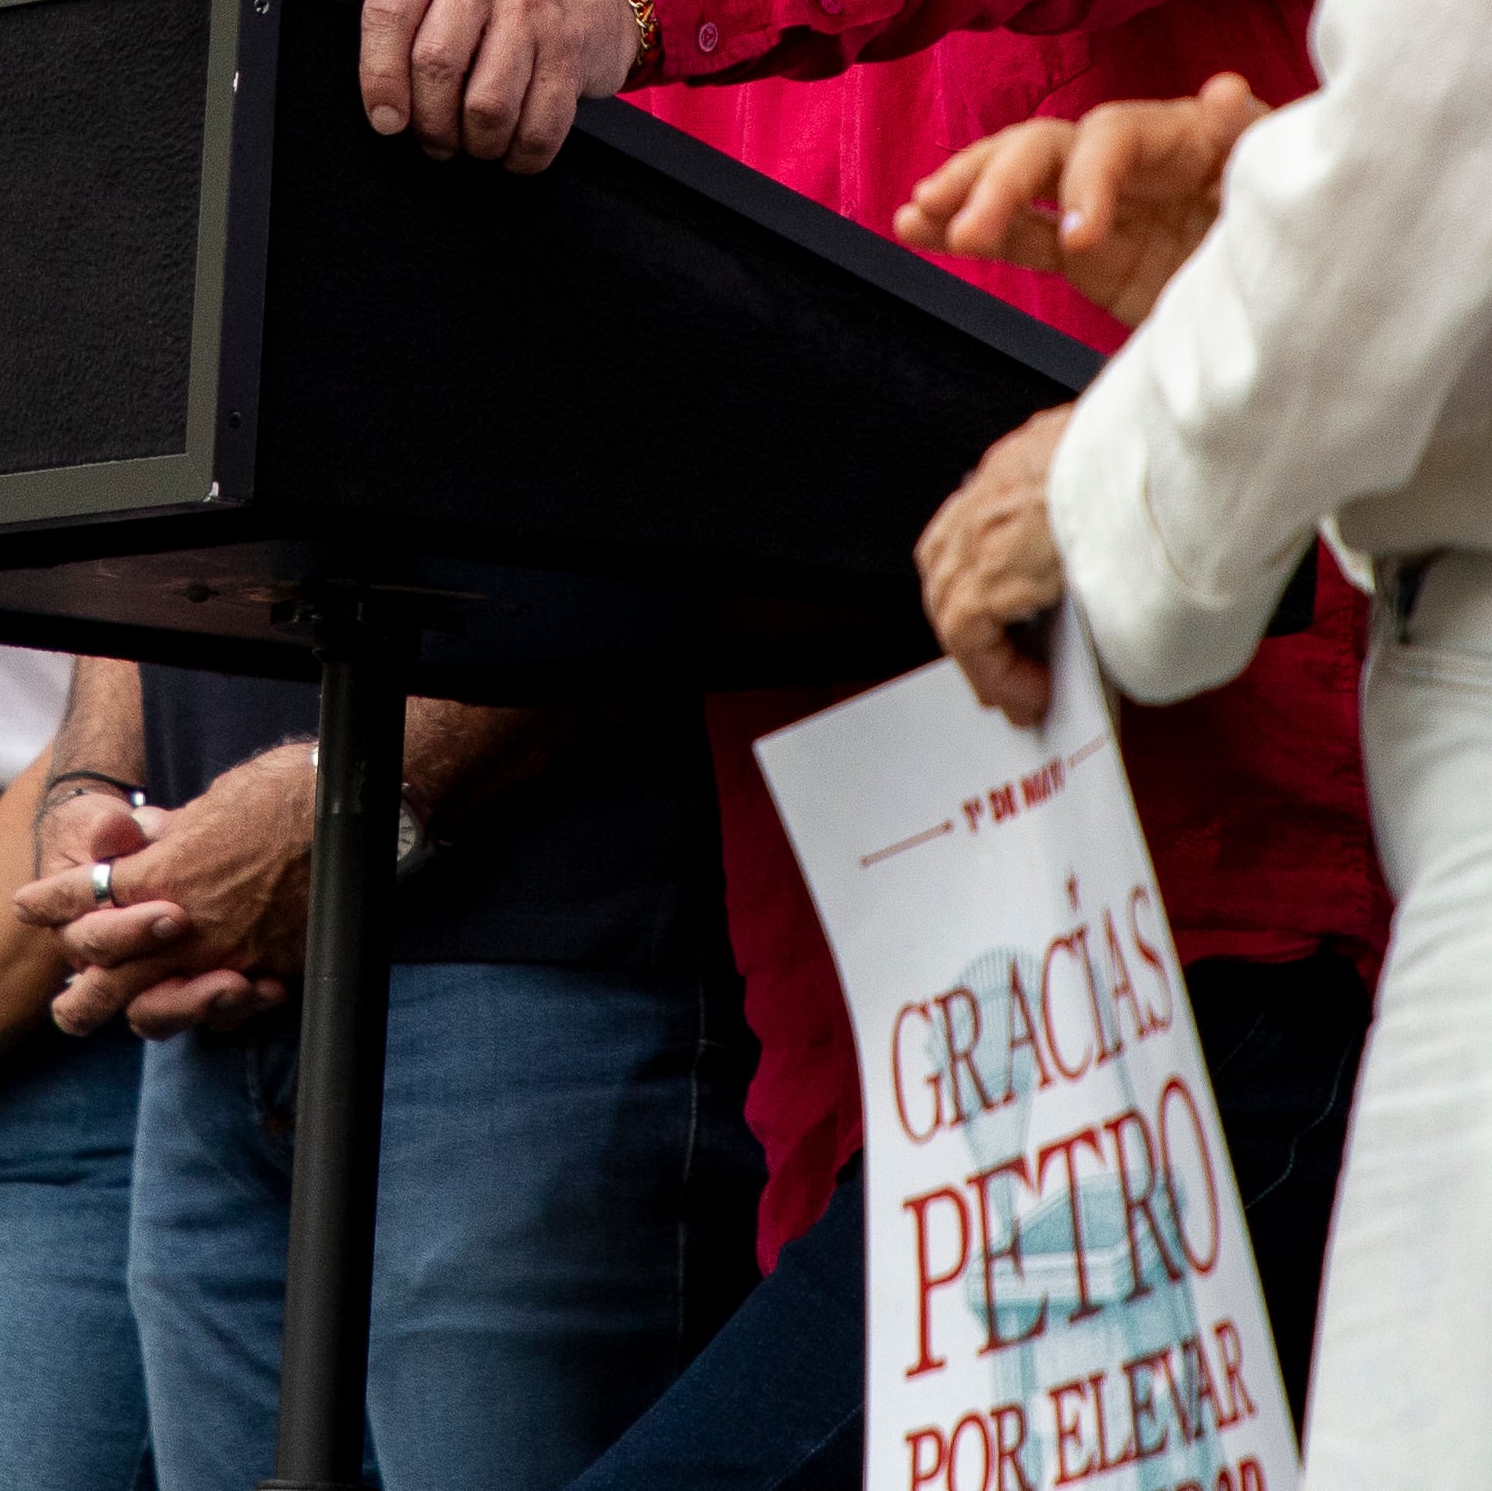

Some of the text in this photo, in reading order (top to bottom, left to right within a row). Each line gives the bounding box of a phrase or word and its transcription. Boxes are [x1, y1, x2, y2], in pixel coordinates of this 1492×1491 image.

[988, 781, 1018, 824] DE
[891, 874, 1174, 1145] GRACÍAS
[903, 1076, 1222, 1381] PETRO
[903, 1319, 1258, 1491] POR ELEVAR
